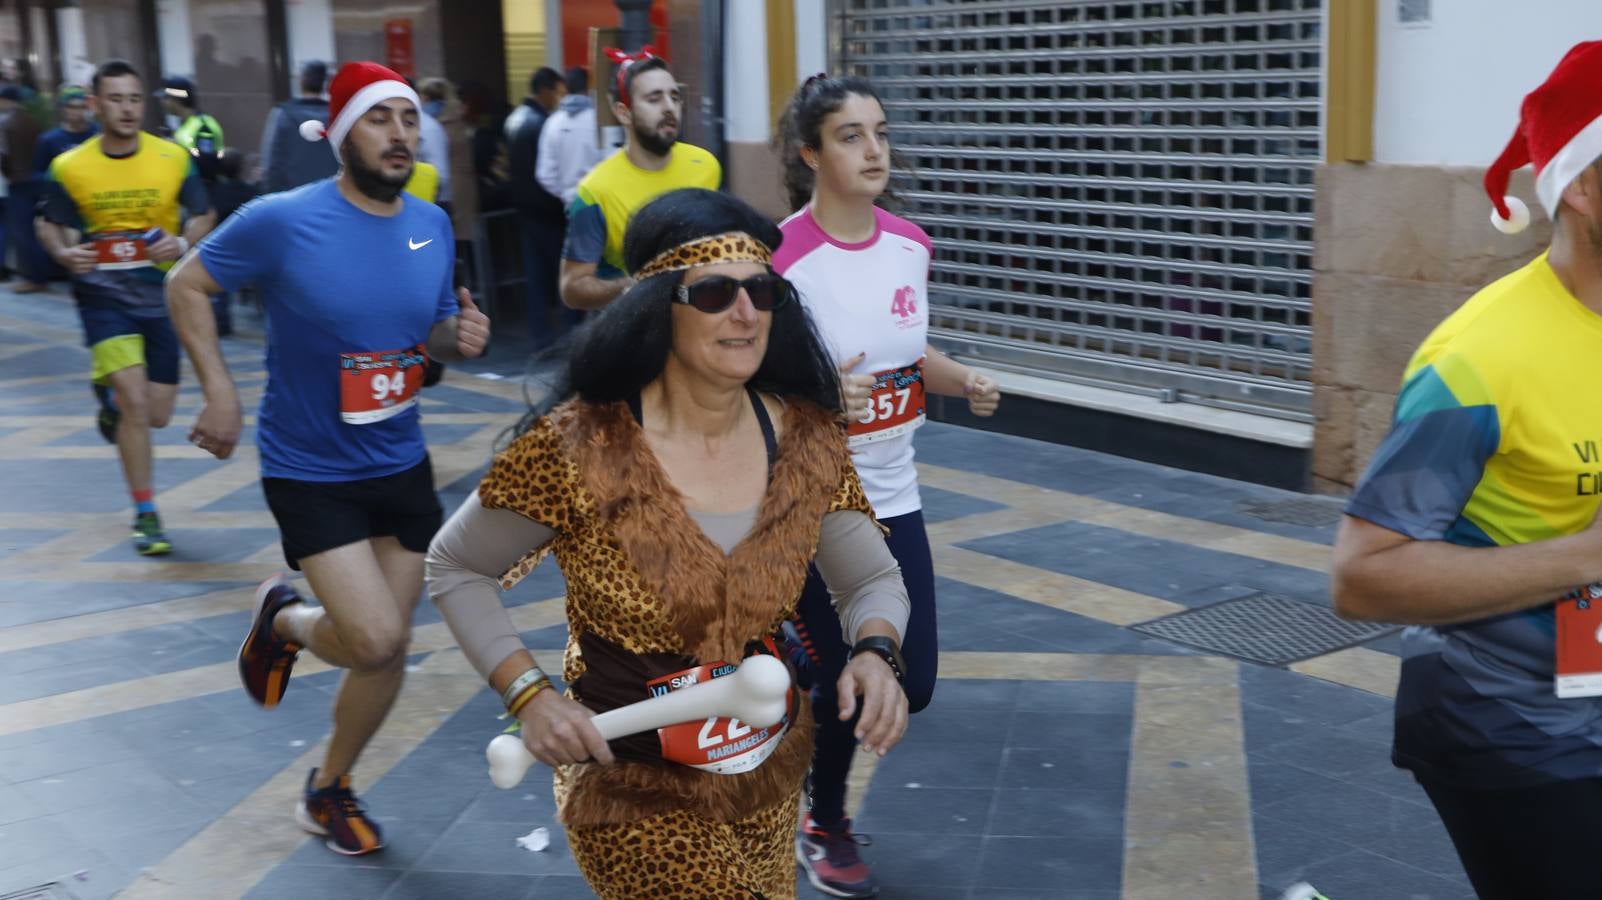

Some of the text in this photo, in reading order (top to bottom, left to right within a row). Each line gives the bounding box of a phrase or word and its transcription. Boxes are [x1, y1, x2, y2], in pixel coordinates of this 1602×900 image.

[371, 371, 405, 400] 94
[671, 674, 697, 688] SAN
[707, 727, 769, 760] MARIANGELES
